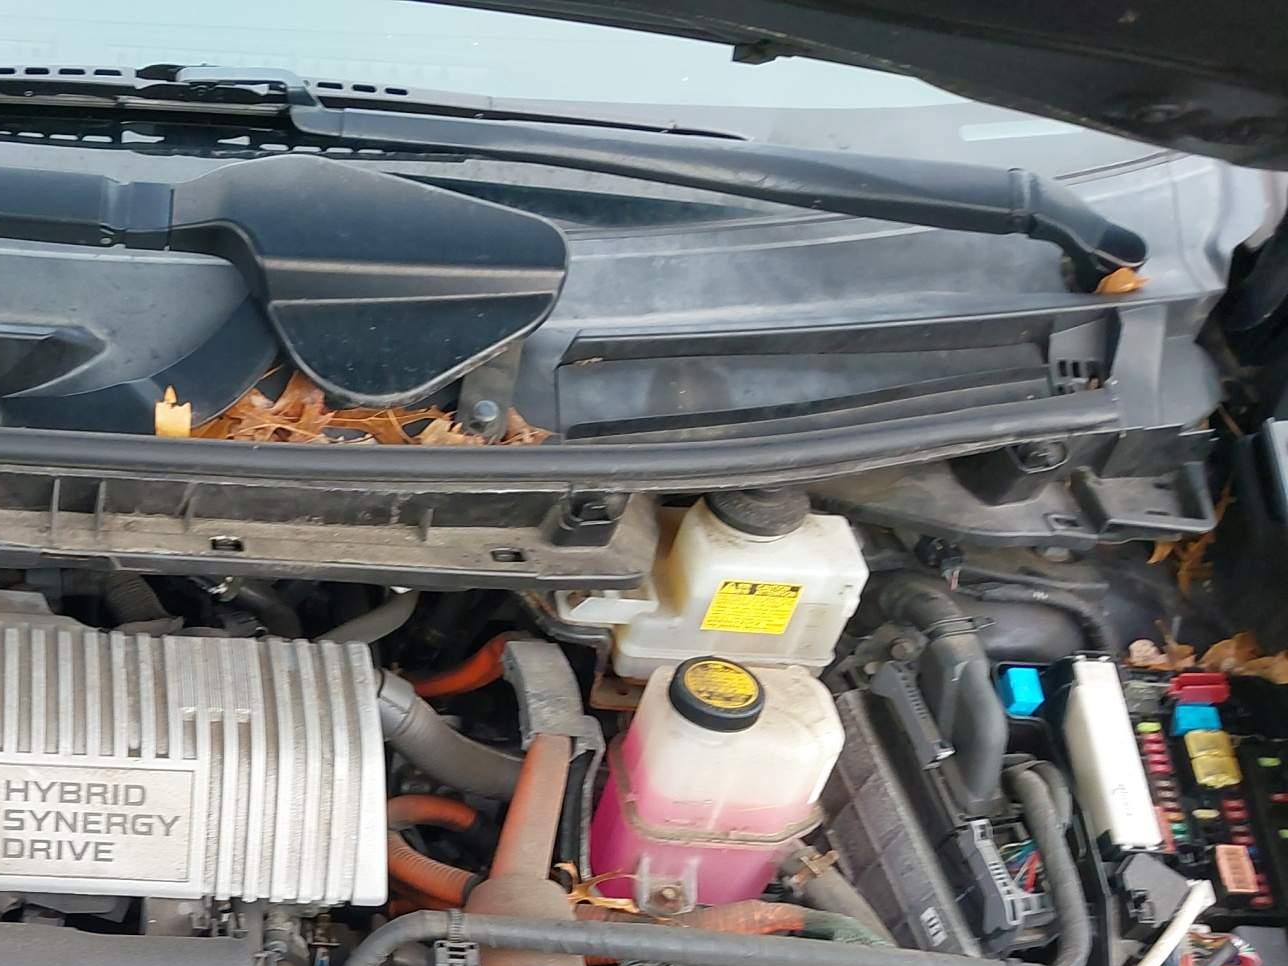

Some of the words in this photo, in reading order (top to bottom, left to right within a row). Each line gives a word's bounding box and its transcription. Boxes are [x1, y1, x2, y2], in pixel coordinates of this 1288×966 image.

[4, 779, 146, 806] HYBRID
[2, 808, 182, 836] SYNERGY
[2, 838, 115, 861] DRIVE
